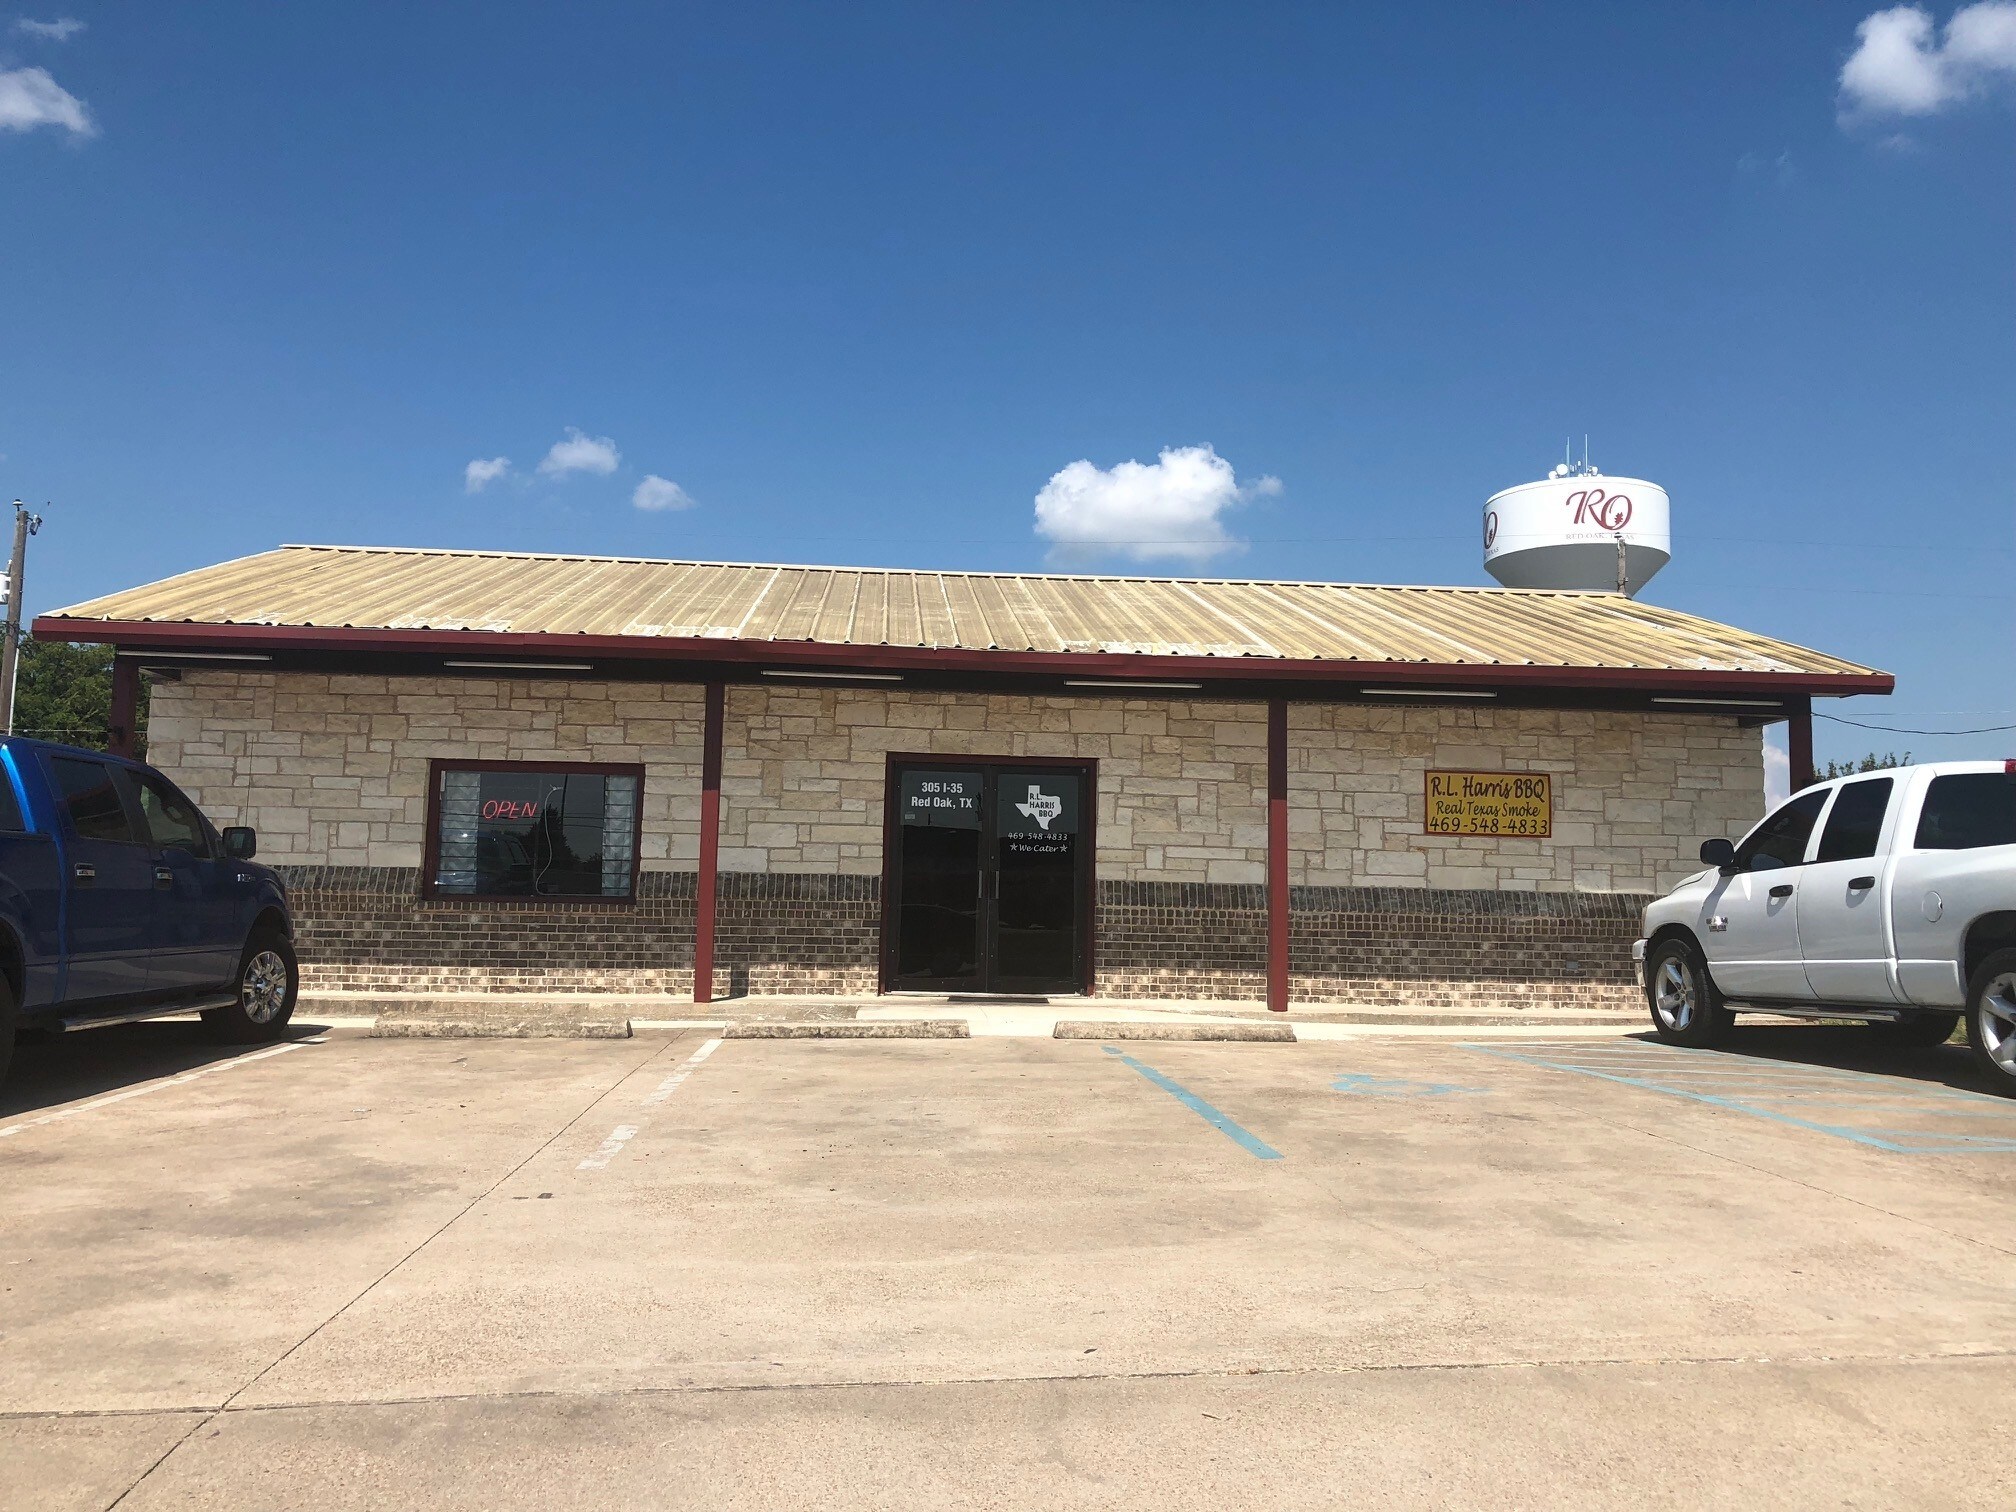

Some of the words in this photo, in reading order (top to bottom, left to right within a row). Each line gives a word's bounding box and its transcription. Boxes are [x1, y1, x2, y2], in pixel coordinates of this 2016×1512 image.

[921, 782, 941, 793] 305
[943, 782, 963, 794] I-35
[1430, 775, 1458, 798] R.L.
[1462, 775, 1513, 799] Harris
[1513, 778, 1546, 803] BBQ
[1029, 792, 1042, 801] R.L.
[911, 796, 931, 808] Red
[933, 797, 956, 810] Oak,
[959, 798, 973, 809] TX
[1029, 801, 1055, 809] HARRIS
[482, 799, 538, 820] OPEN
[1038, 809, 1053, 818] BBQ
[1435, 800, 1466, 816] Real
[1466, 801, 1501, 818] Texas
[1501, 802, 1541, 818] Smoke
[1007, 832, 1024, 840] 469
[1019, 843, 1033, 852] We
[1033, 844, 1059, 853] Cater
